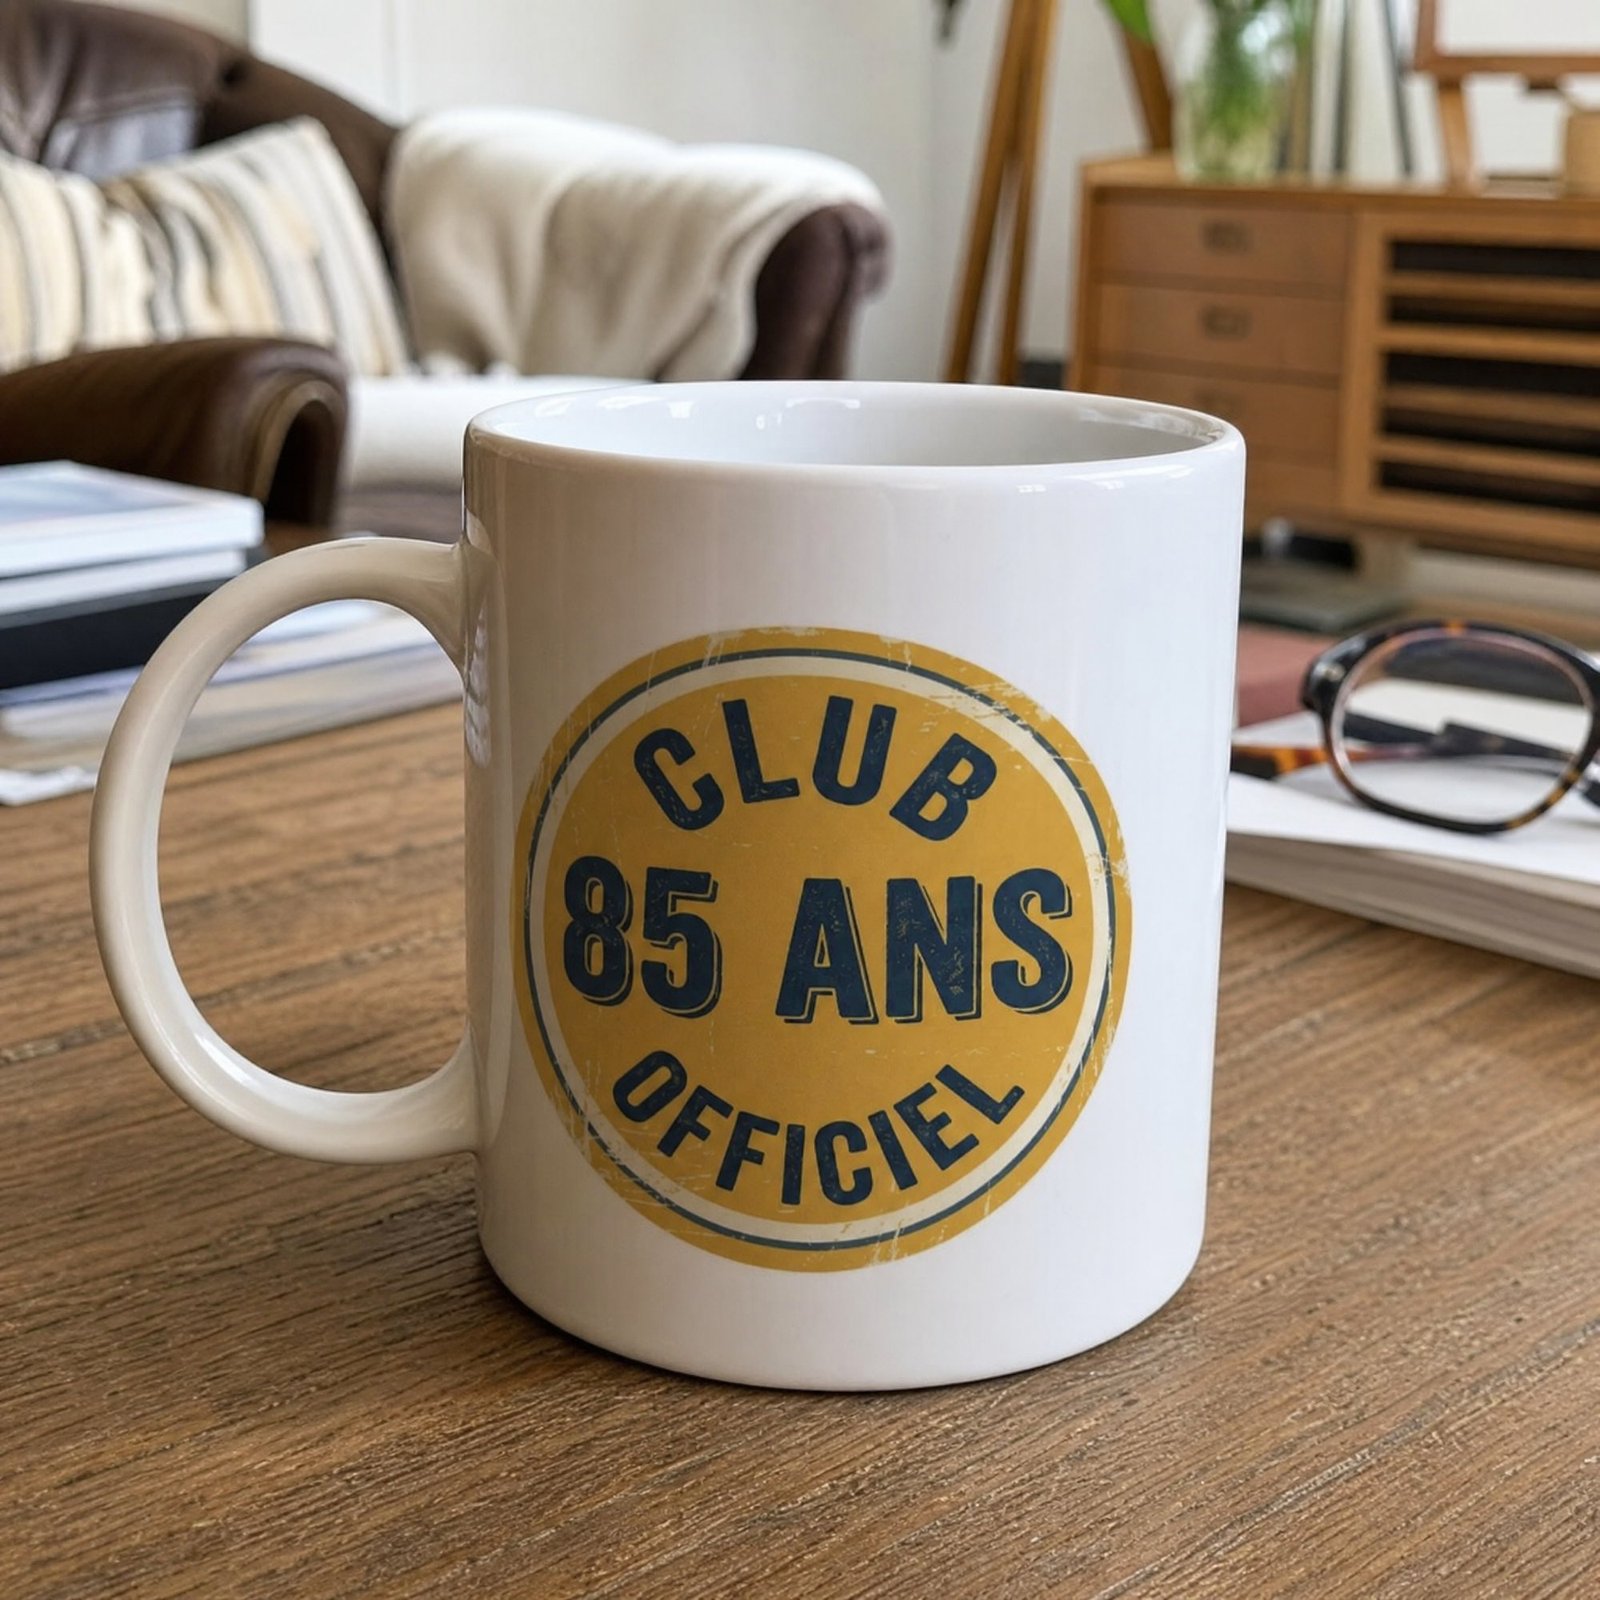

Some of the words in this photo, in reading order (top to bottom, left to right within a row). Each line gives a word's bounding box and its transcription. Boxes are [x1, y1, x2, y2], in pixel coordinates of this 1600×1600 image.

[633, 695, 997, 841] CLUB
[563, 856, 722, 1018] 85
[774, 868, 1073, 1024] ANS
[612, 1050, 1025, 1206] OFFICIEL
